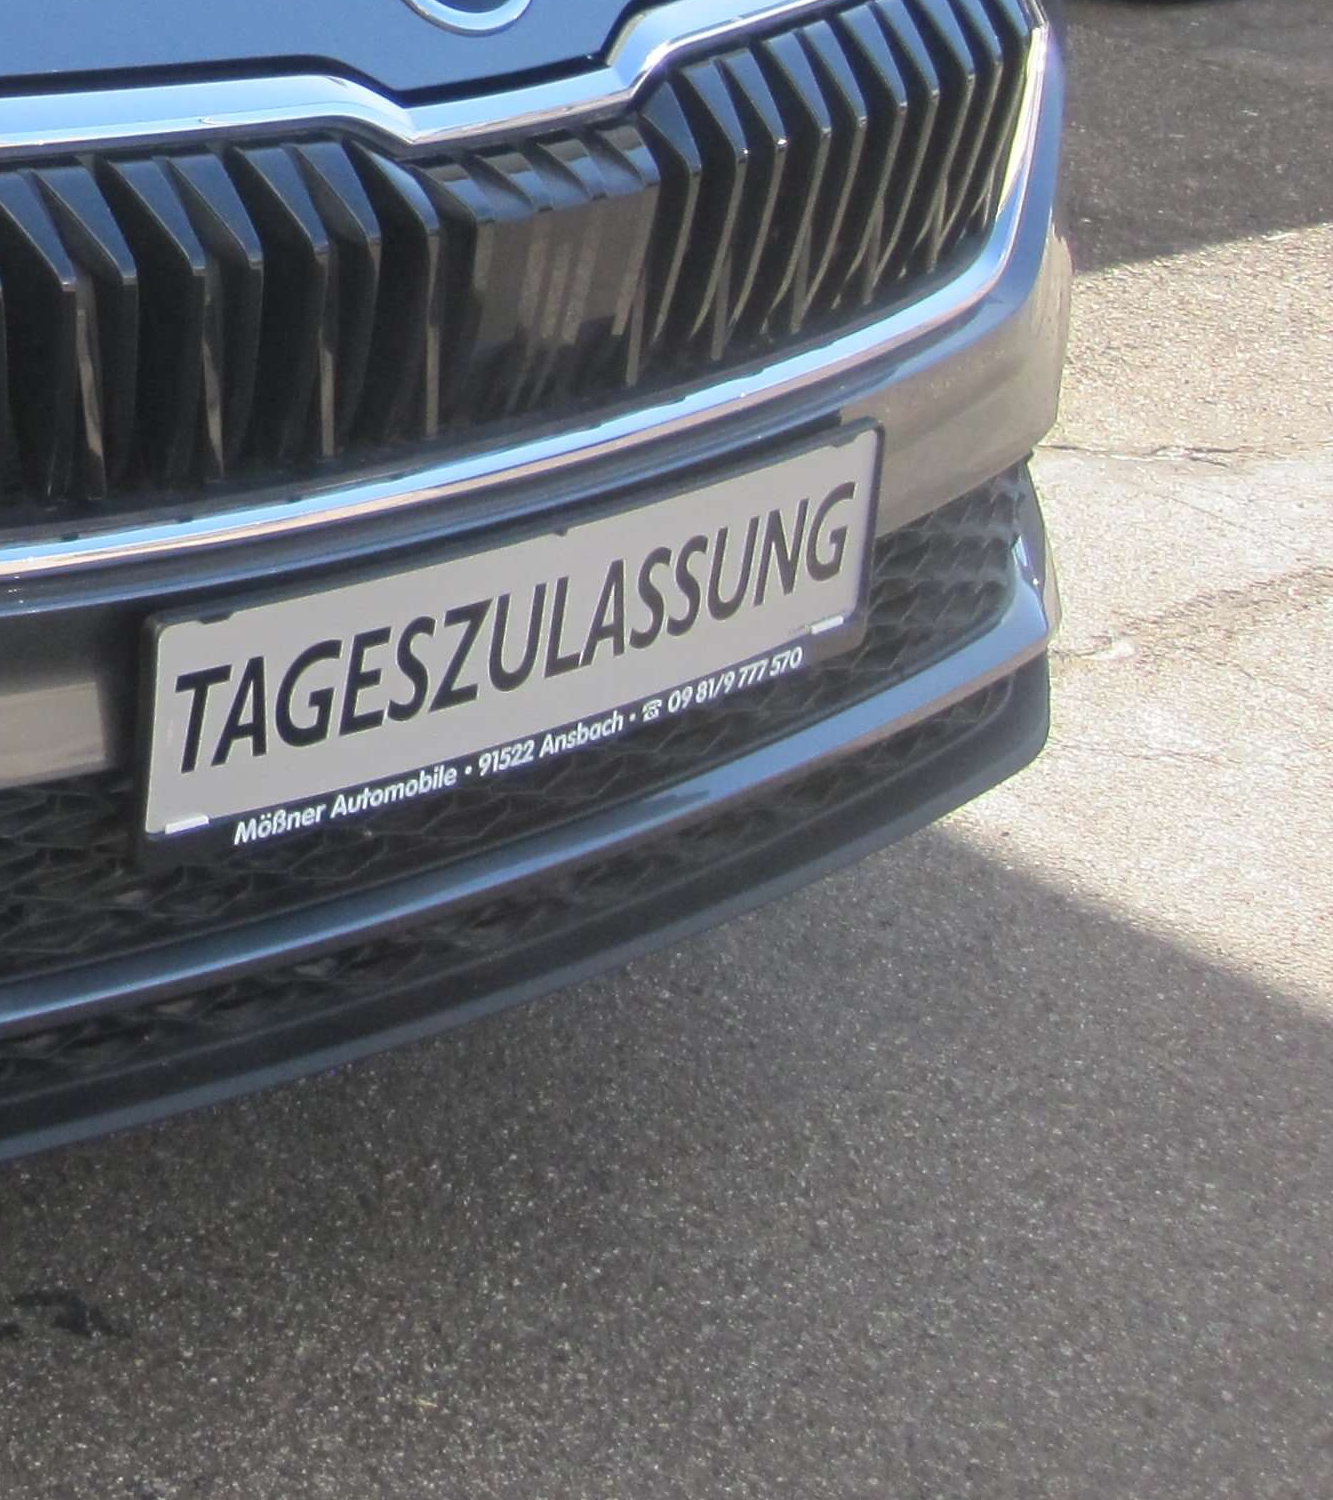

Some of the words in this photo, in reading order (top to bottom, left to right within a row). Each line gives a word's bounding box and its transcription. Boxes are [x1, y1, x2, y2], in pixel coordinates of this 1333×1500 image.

[174, 481, 856, 773] TAGESZULASSUNG
[233, 804, 326, 845] Mößner
[330, 767, 458, 820] Automobile
[477, 740, 536, 778] 91522
[538, 709, 625, 759] Ansbach
